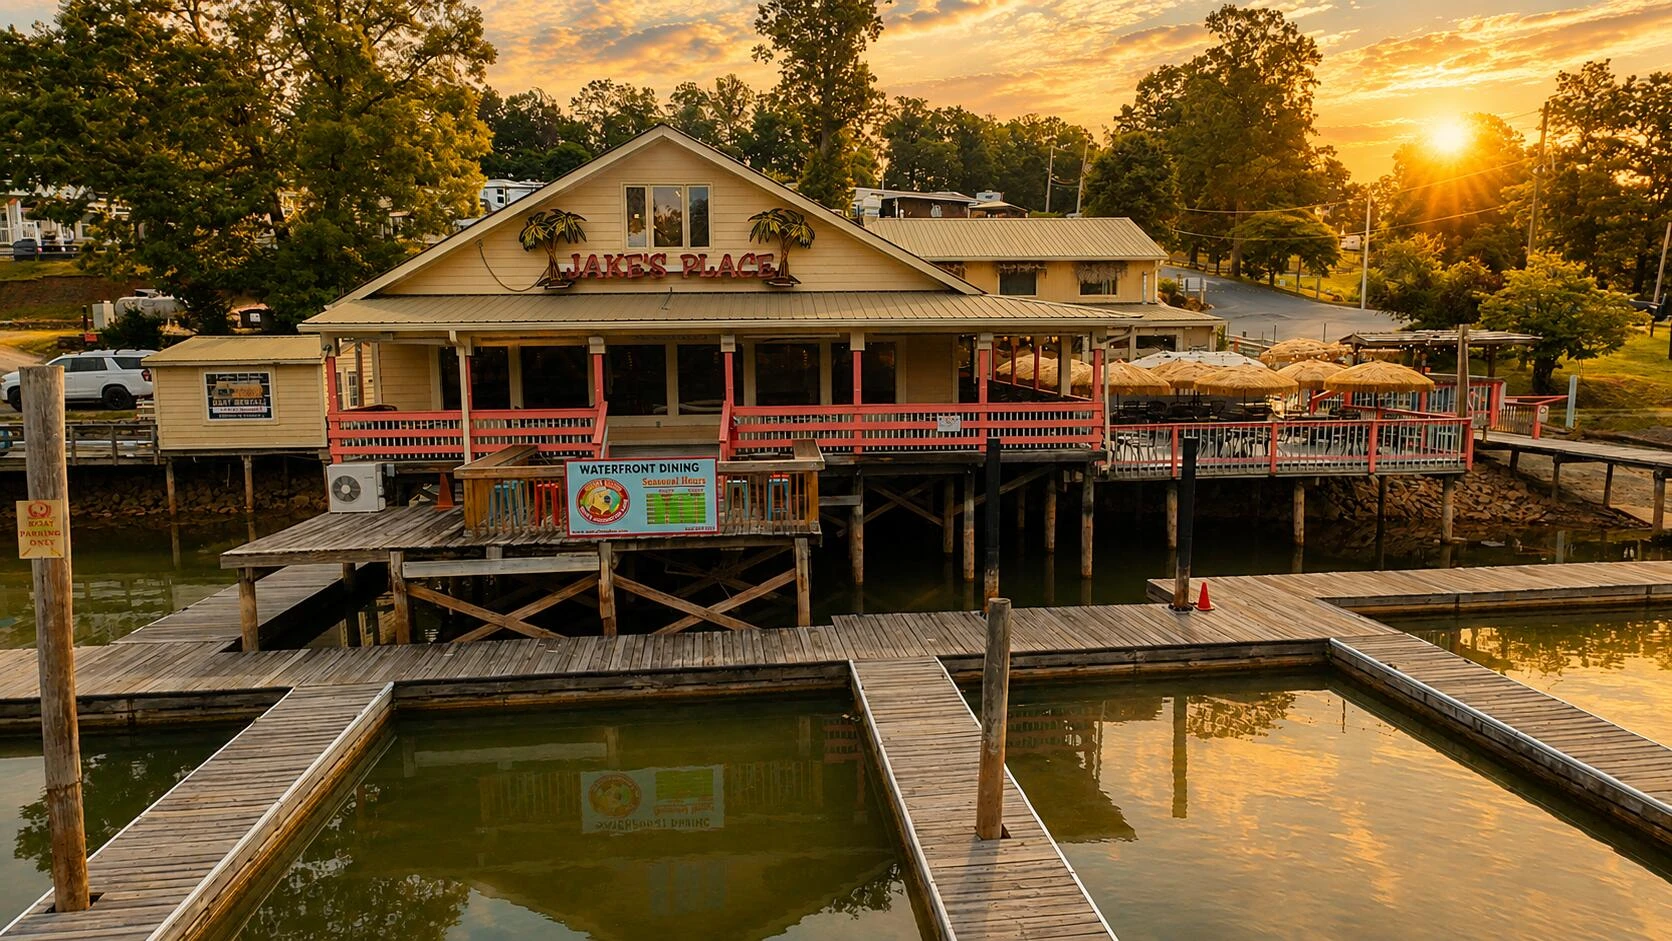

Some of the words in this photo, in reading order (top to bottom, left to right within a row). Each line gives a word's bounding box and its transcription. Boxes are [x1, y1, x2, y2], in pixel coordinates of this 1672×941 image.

[566, 253, 667, 279] JAKE'S
[680, 253, 776, 279] PLACE
[580, 463, 656, 475] WATERFRONT
[659, 462, 700, 473] DINING
[682, 476, 706, 485] Hours
